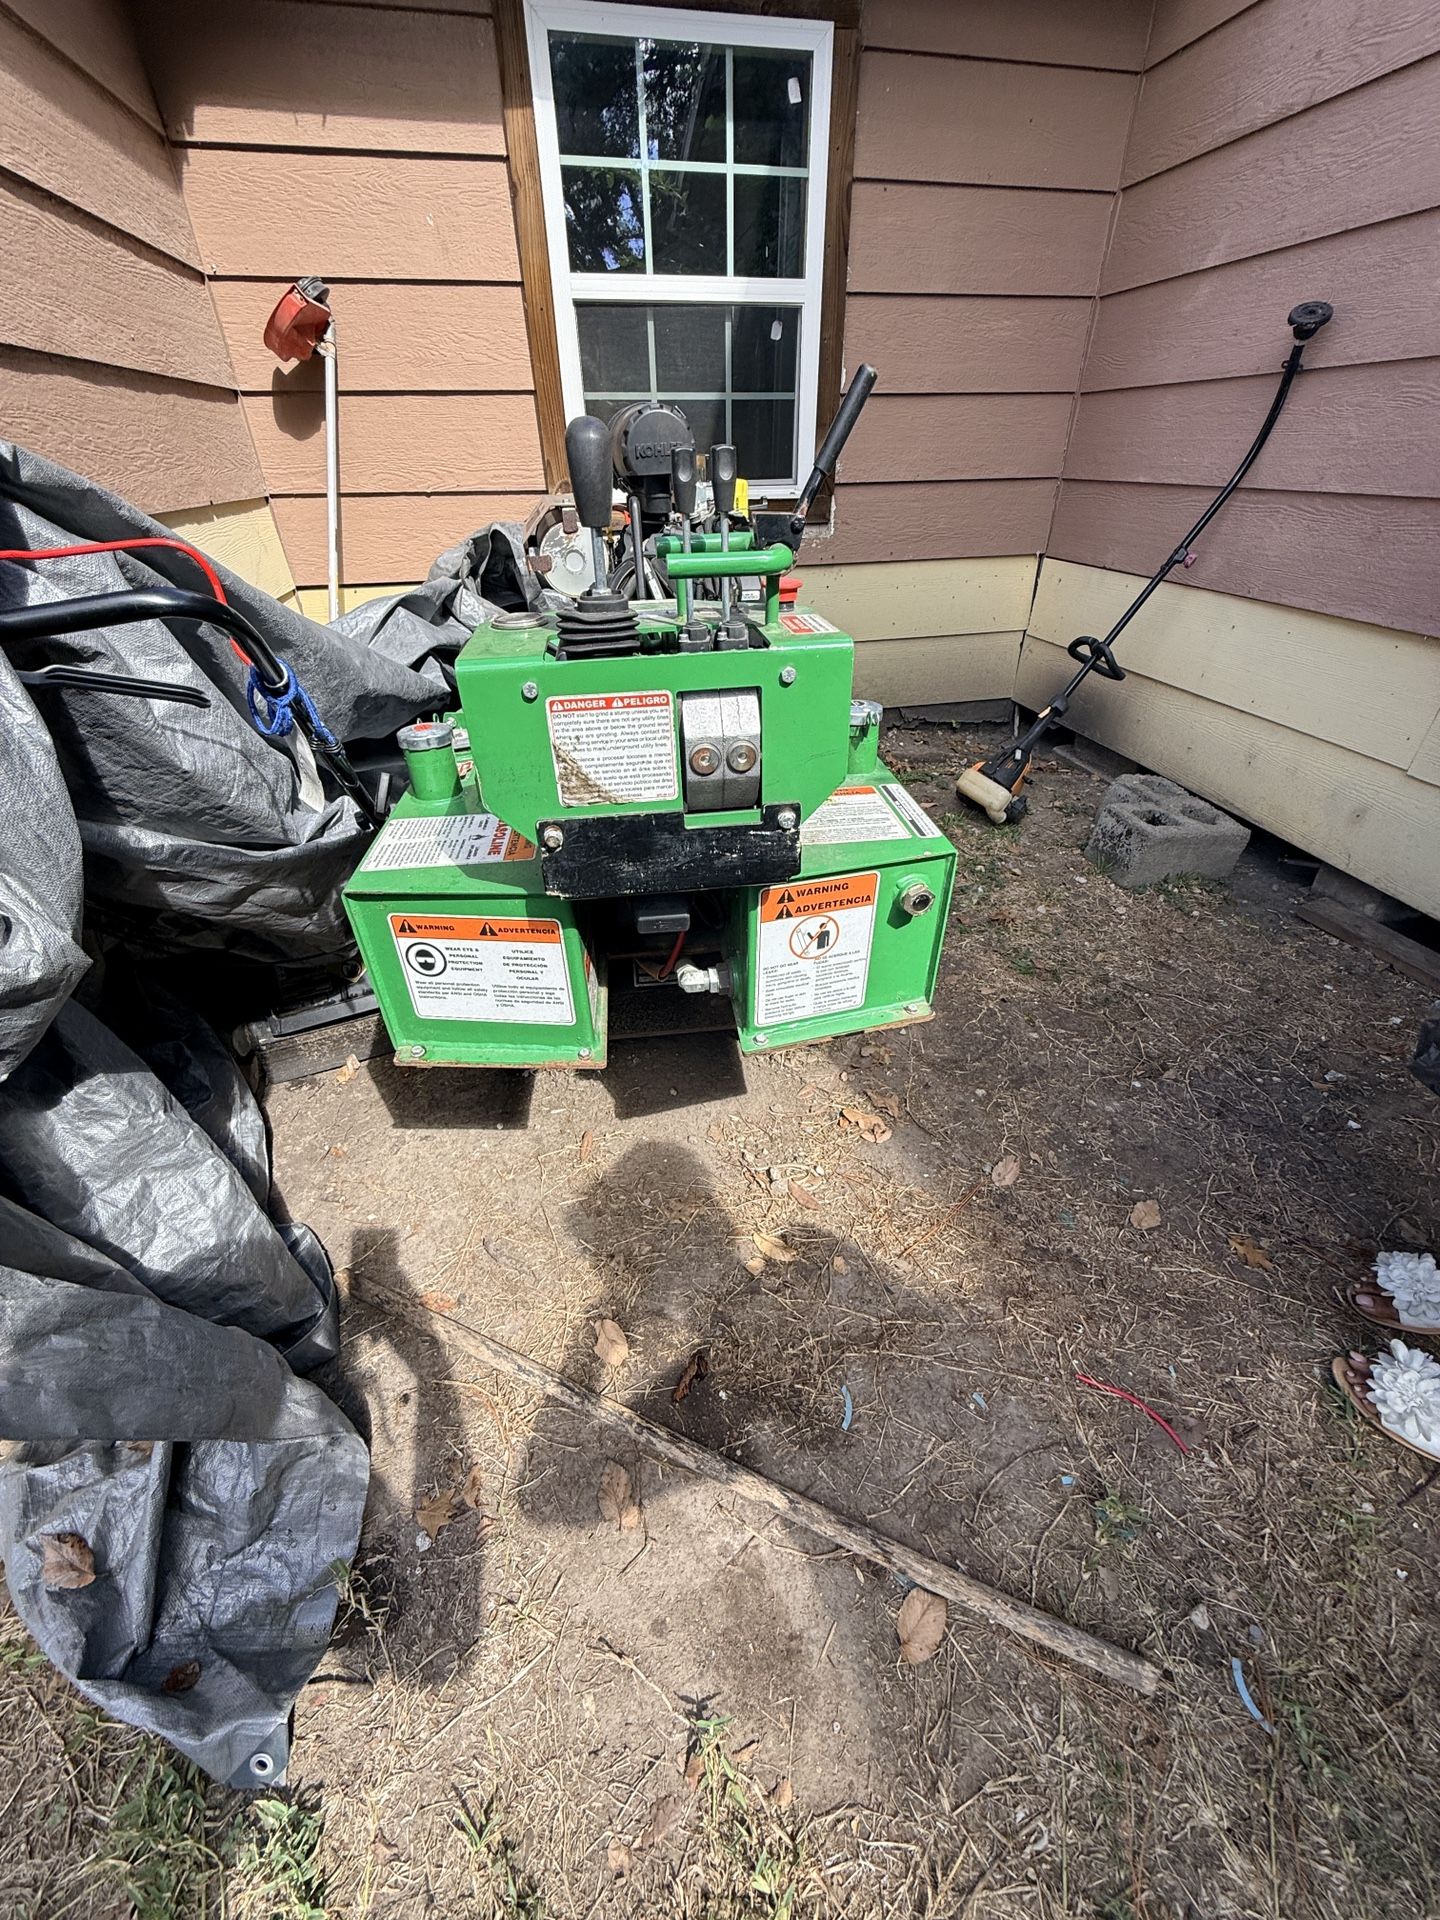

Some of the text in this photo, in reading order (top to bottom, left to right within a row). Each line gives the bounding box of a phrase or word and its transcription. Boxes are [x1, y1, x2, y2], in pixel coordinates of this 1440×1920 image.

[635, 442, 681, 459] KOHL
[563, 700, 606, 709] DANGER
[623, 696, 667, 706] PELIGRO
[796, 882, 849, 898] WARNING
[795, 894, 872, 914] ADVERTENCIA
[415, 924, 455, 932] WARNING
[497, 927, 556, 935] ADVERTENCIA
